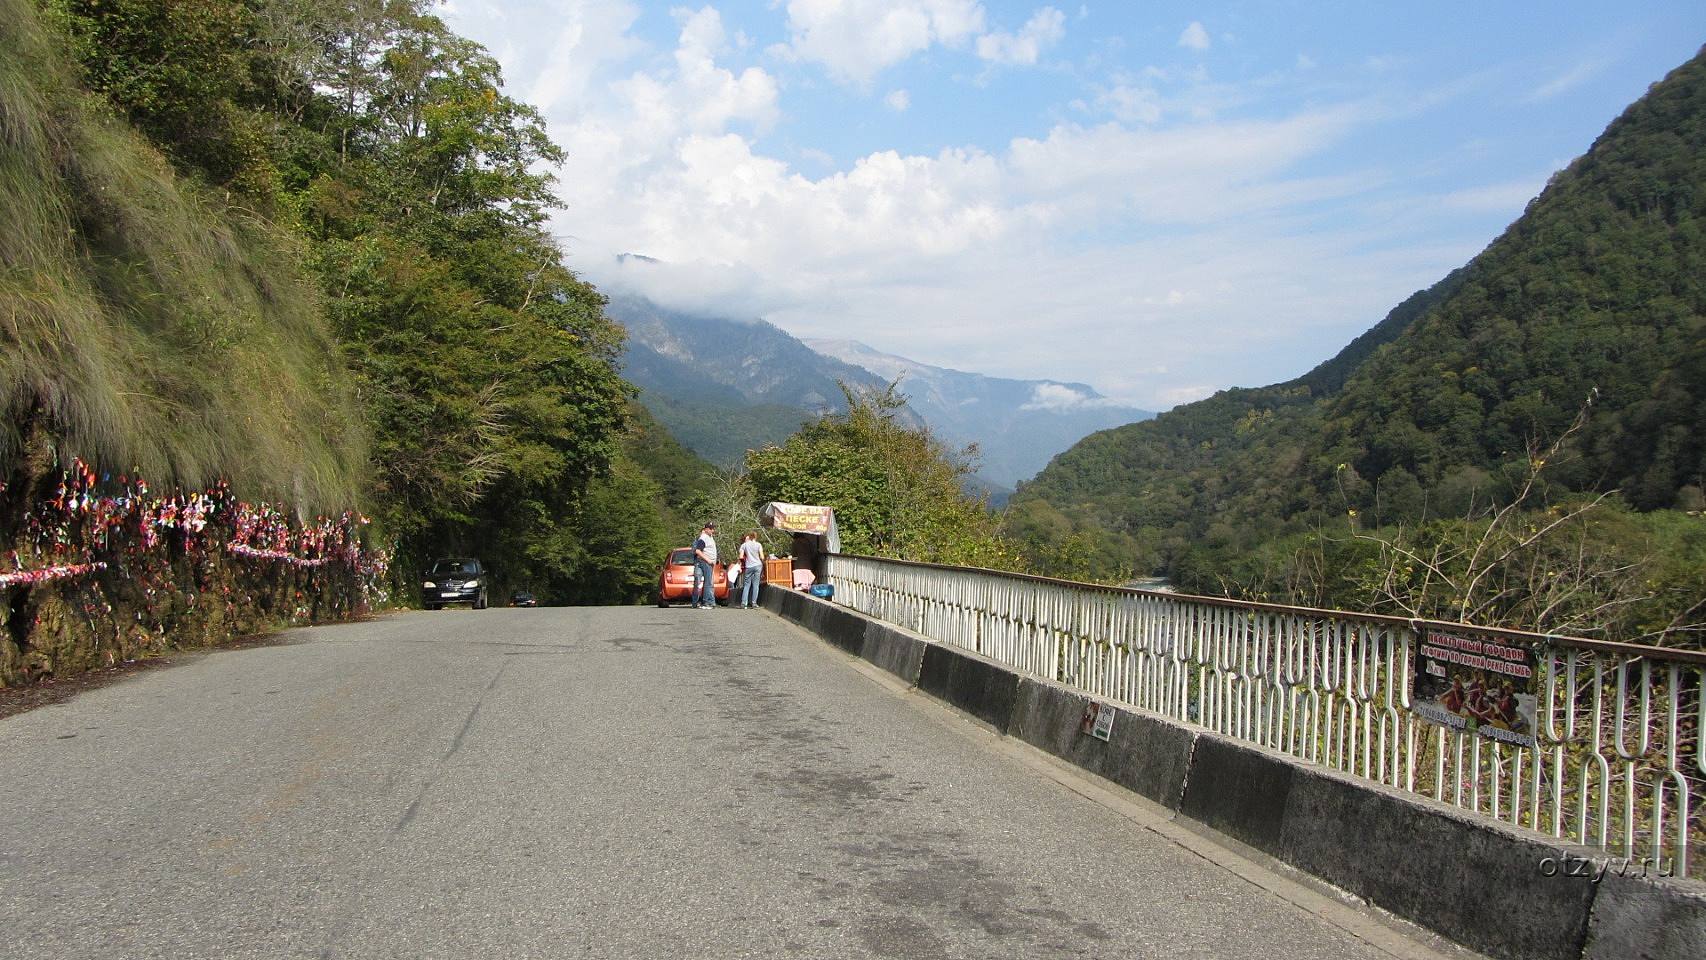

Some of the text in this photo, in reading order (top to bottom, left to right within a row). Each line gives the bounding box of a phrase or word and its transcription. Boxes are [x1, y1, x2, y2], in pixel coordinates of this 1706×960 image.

[786, 514, 820, 524] ПЕСКЕ
[1427, 632, 1525, 662] ПАЛАТОЧНЫЙ ГОРОДОК
[1449, 651, 1460, 663] ПО
[1460, 653, 1486, 669] ГОРНОЙ
[1486, 658, 1504, 673] РЕКЕ
[1504, 662, 1532, 678] БЗЫБЬ
